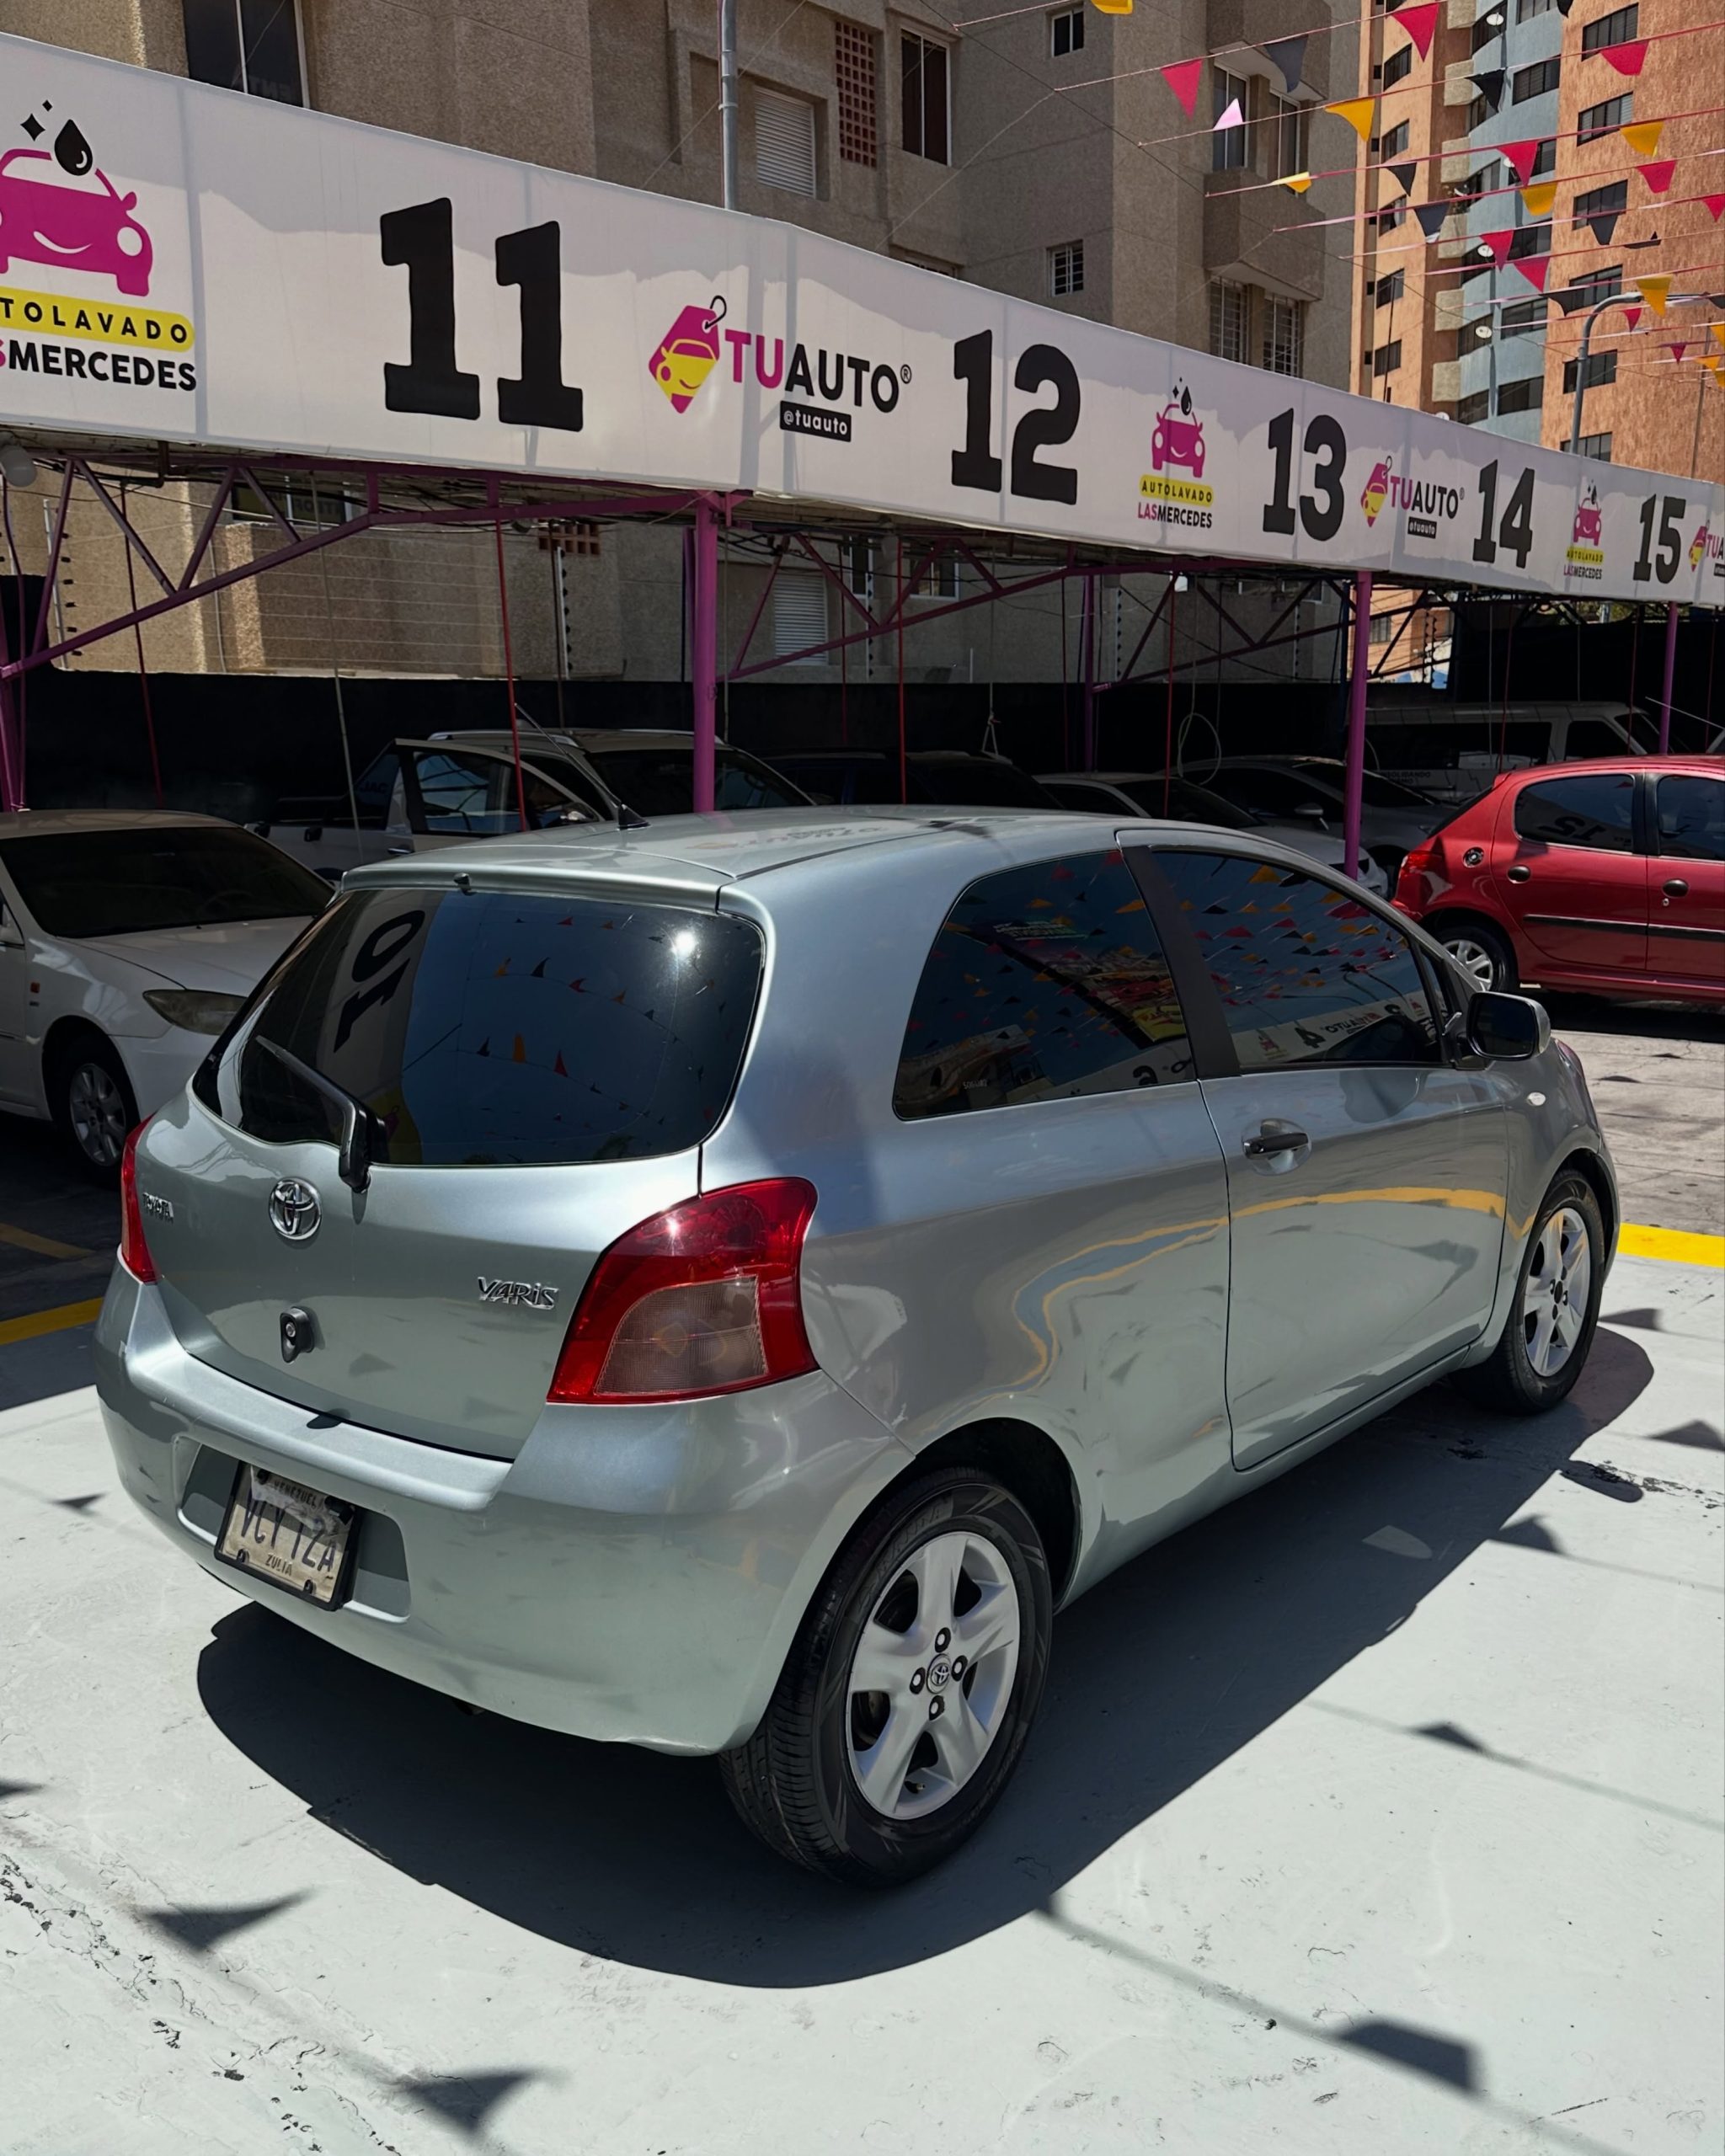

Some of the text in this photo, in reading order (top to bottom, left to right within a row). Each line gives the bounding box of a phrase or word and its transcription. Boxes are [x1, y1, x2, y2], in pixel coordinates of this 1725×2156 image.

[381, 197, 583, 432] 11
[783, 410, 848, 435] @tuauto
[952, 329, 1081, 505] 12
[1141, 480, 1212, 503] AUTOLAVADO
[1263, 407, 1347, 542] 13
[1409, 521, 1435, 535] @tuauto
[1472, 459, 1535, 568] 14
[1633, 494, 1686, 584] 15
[1567, 550, 1603, 563] AUTOLAVADO
[264, 1553, 293, 1577] ZULIA
